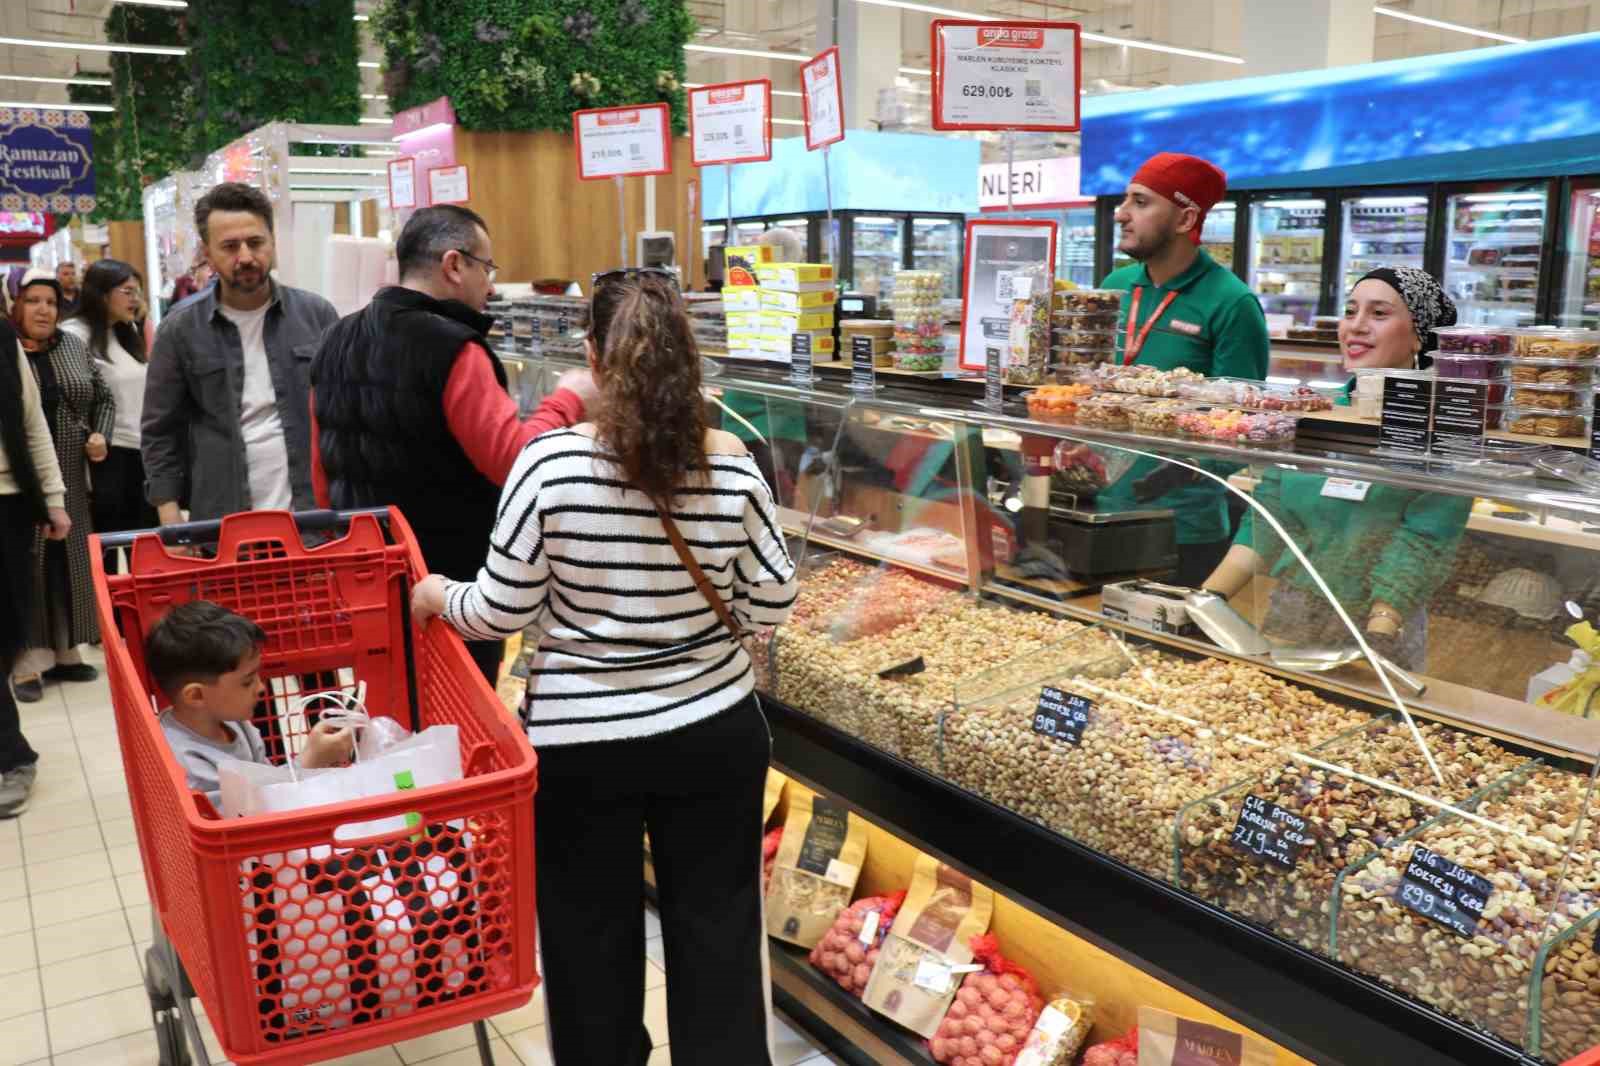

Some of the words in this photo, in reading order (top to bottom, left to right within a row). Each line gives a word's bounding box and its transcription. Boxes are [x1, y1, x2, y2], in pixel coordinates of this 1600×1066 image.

[962, 84, 1014, 99] 629,00₺
[0, 144, 79, 163] Ramazan
[1272, 807, 1305, 832] ATOM
